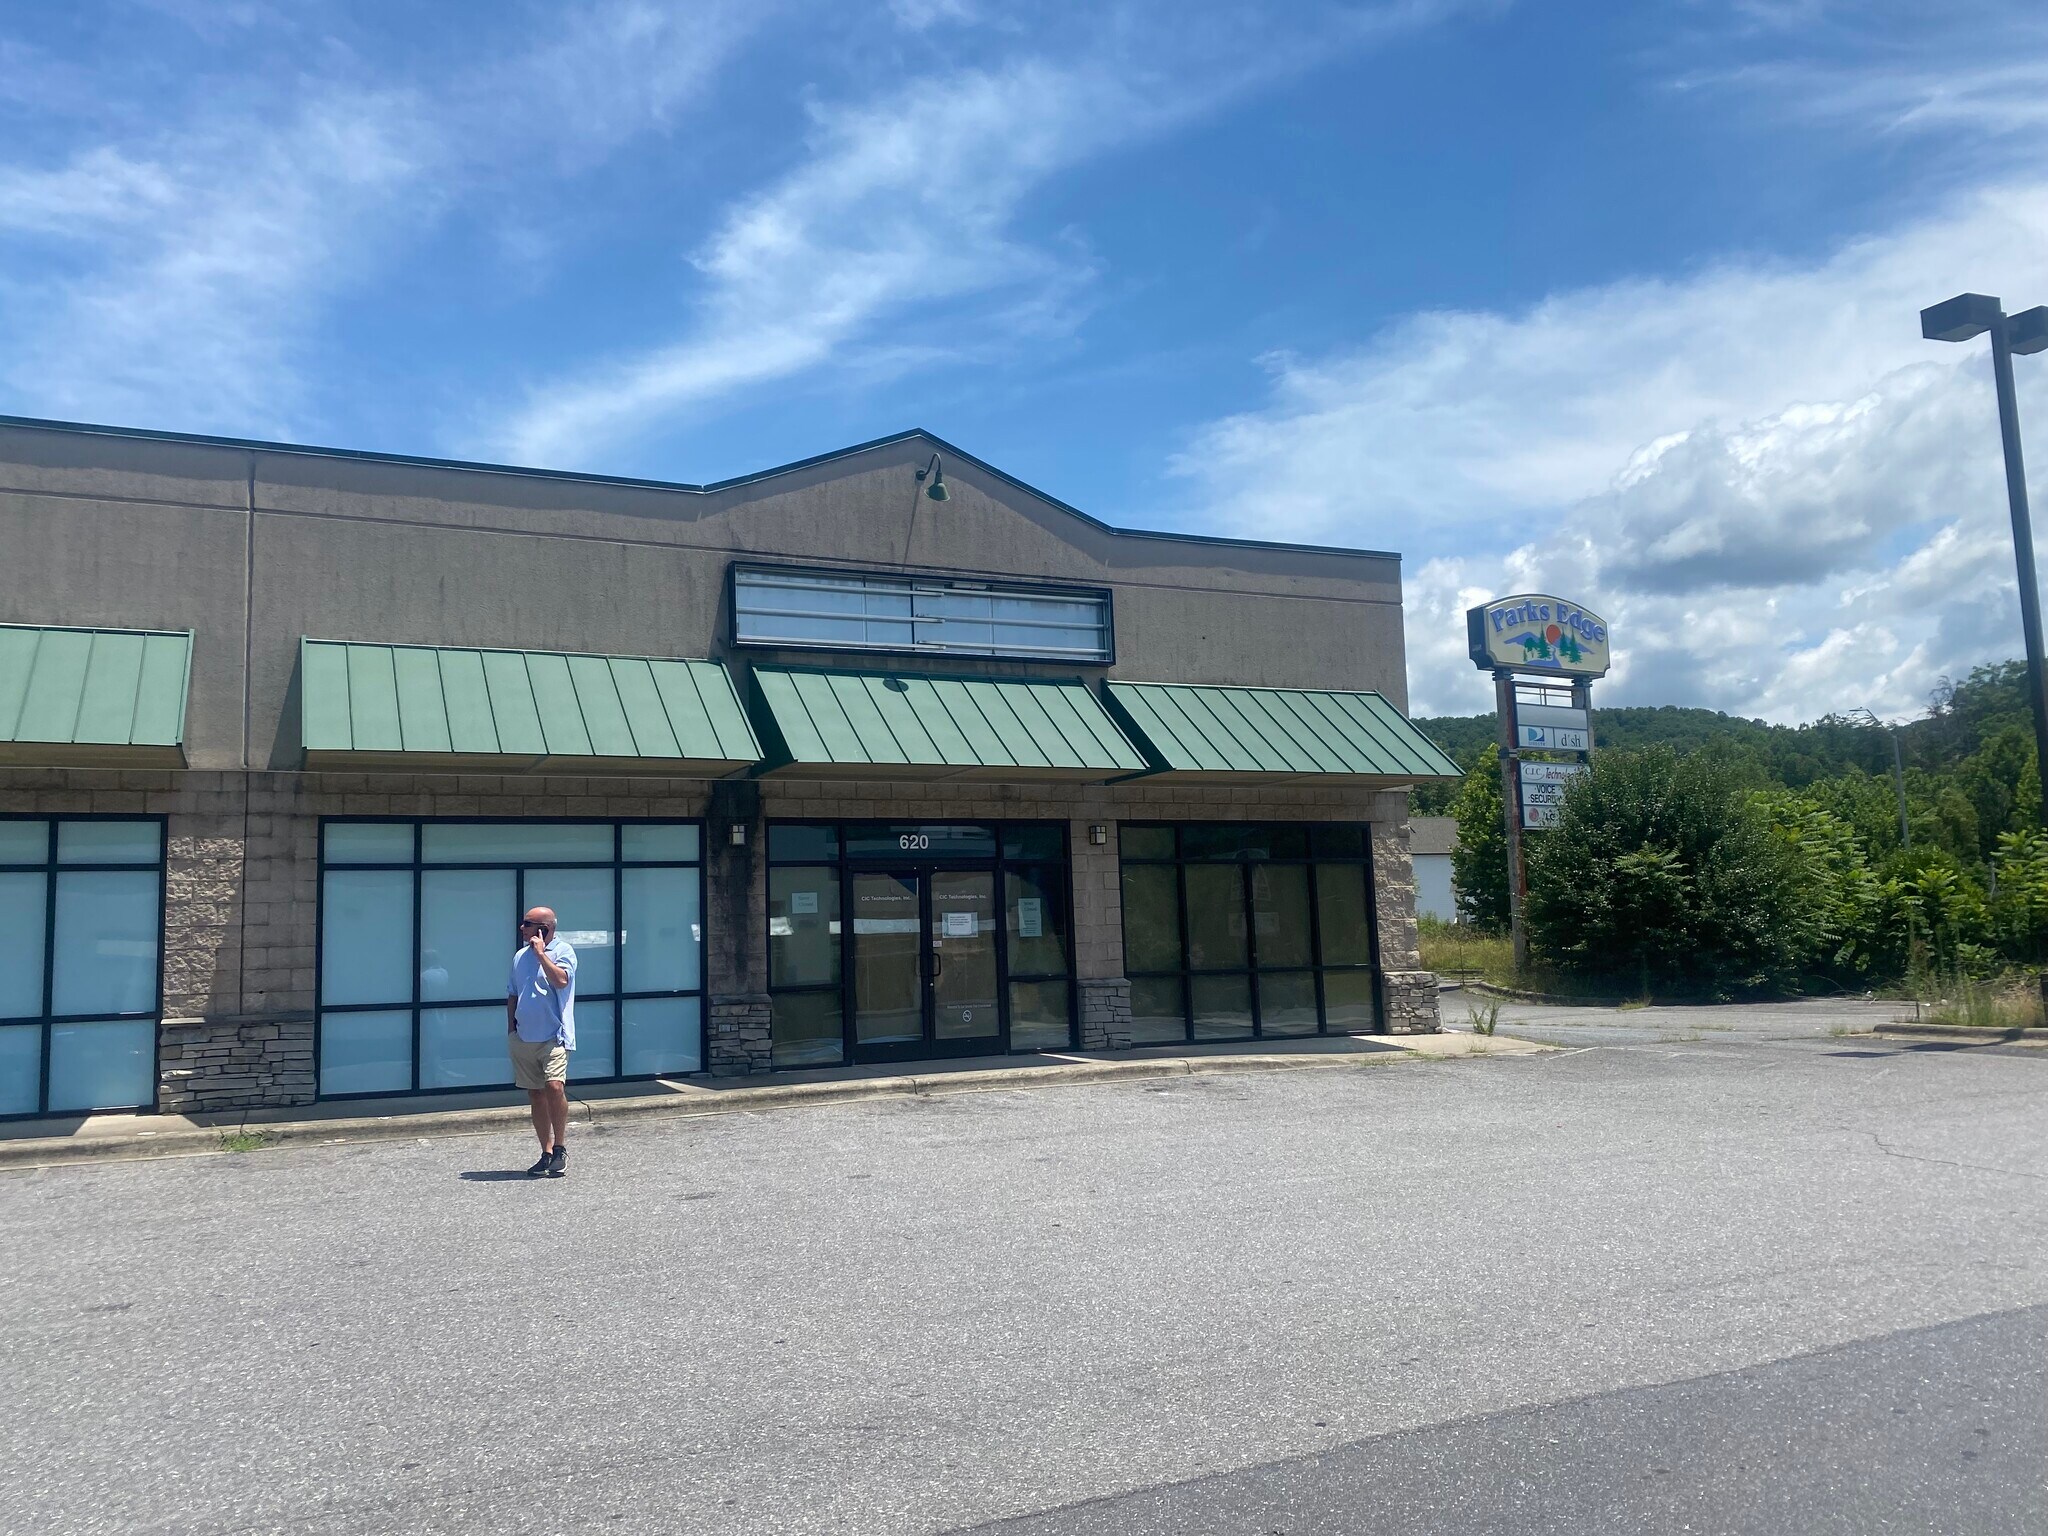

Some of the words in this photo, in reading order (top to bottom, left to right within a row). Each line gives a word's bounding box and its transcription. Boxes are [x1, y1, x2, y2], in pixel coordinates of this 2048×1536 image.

[1489, 600, 1550, 633] Parks
[1556, 602, 1606, 643] Edge
[1536, 784, 1556, 794] VOICE
[899, 834, 929, 850] 620
